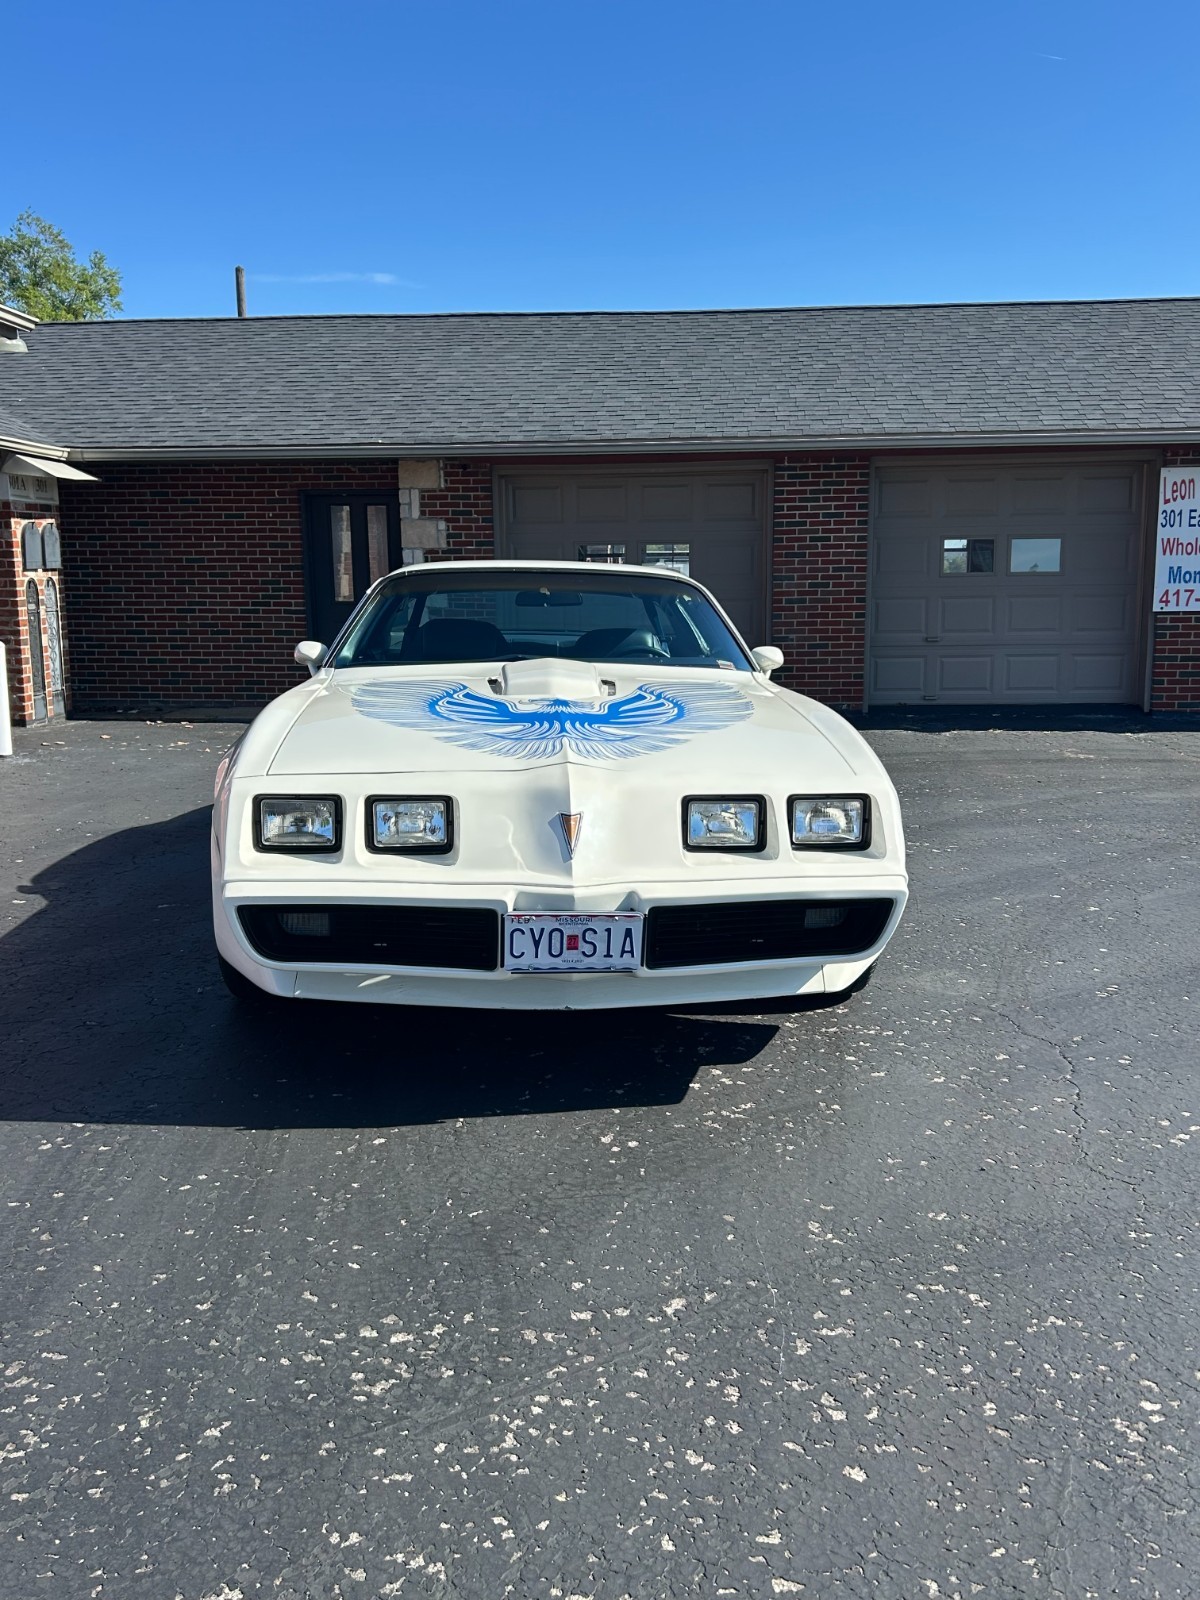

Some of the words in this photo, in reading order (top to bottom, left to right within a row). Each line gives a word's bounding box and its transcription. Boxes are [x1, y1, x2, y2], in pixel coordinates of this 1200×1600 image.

[35, 478, 48, 493] 301
[1163, 476, 1195, 505] Leon
[1160, 509, 1183, 528] 301
[1161, 537, 1200, 556] Whol
[568, 937, 577, 946] 27
[581, 927, 635, 958] S1A
